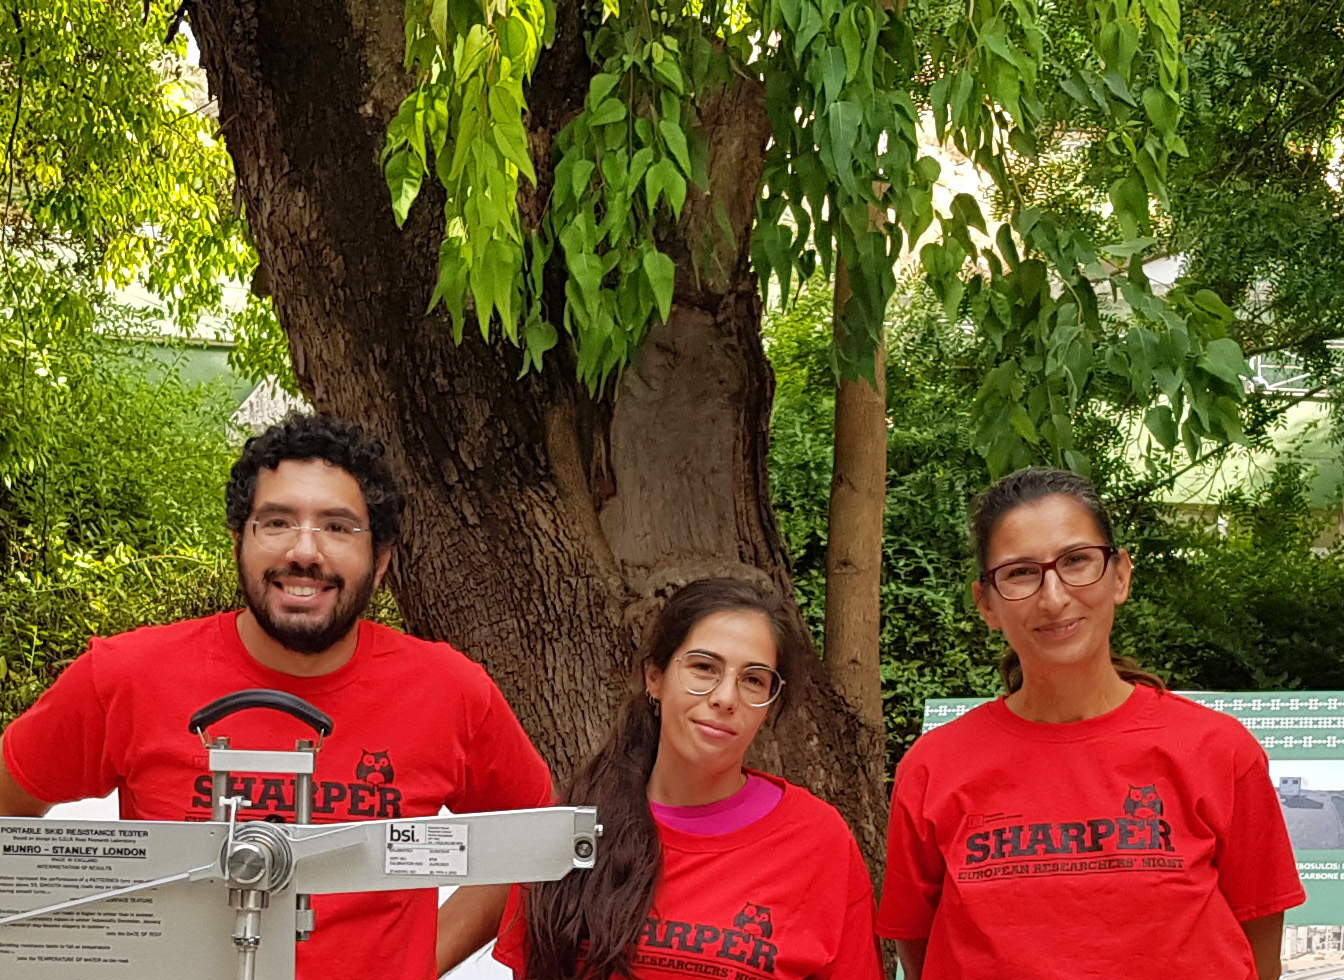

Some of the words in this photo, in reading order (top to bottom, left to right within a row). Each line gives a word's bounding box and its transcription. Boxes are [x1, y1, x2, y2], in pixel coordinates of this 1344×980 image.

[0, 827, 41, 836] PORTABLE
[66, 828, 116, 837] RESISTANCE
[118, 830, 149, 838] TESTER
[390, 824, 420, 842] bsi.
[966, 816, 1175, 866] SHARPER
[3, 845, 42, 854] MUNRO
[52, 846, 98, 855] STANLEY
[103, 847, 146, 856] LONDON
[957, 864, 1029, 880] EUROPEAN
[1142, 858, 1185, 869] NIGHT
